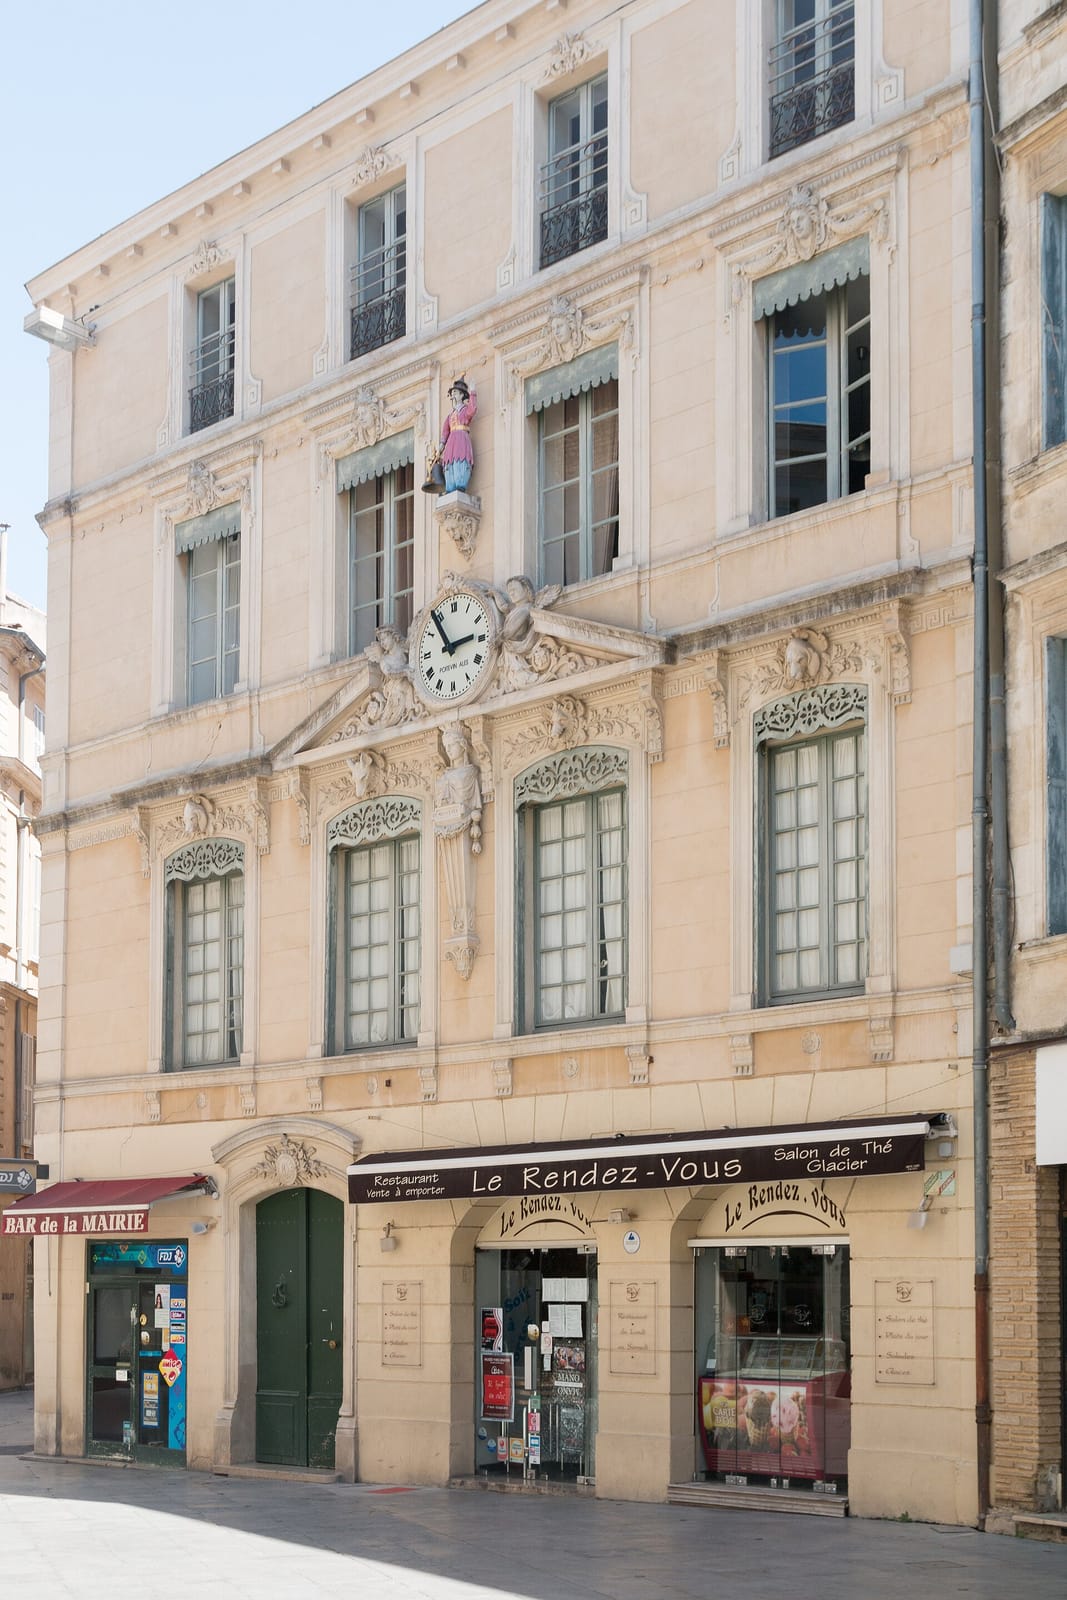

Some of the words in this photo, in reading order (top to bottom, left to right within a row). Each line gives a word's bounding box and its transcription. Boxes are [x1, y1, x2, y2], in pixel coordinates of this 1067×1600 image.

[774, 1147, 818, 1161] Salon
[829, 1143, 849, 1158] de
[862, 1138, 893, 1154] Thé
[806, 1158, 868, 1173] Glacier
[374, 1172, 439, 1186] Restaurant
[472, 1170, 502, 1192] Le
[366, 1188, 391, 1198] Vente
[395, 1187, 401, 1197] à
[405, 1186, 445, 1198] emporter
[4, 1216, 37, 1234] BAR
[40, 1216, 58, 1233] de
[63, 1215, 78, 1232] la
[81, 1212, 145, 1232] MAIRIE
[500, 1210, 515, 1237] Le
[725, 1202, 742, 1232] Le
[159, 1251, 173, 1261] FDJ
[713, 1406, 737, 1417] CARTE
